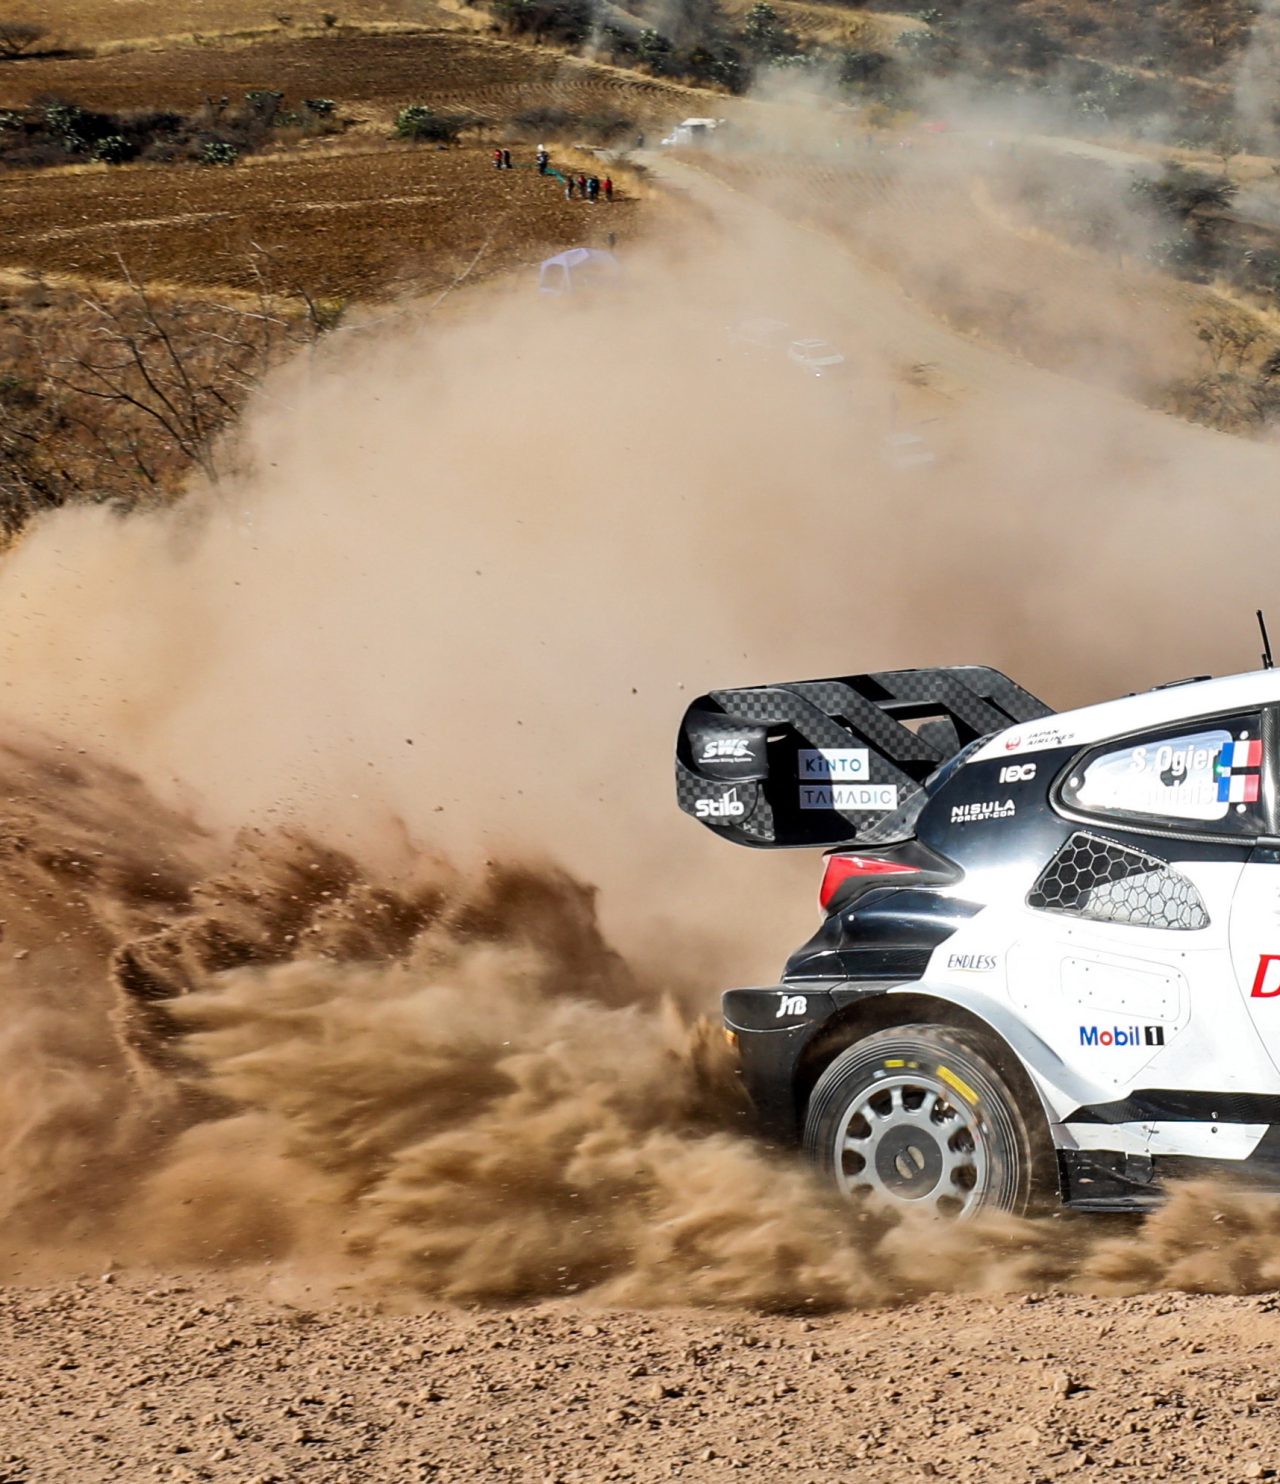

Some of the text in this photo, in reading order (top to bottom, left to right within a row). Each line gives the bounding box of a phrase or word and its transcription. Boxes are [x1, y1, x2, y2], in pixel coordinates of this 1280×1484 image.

[1154, 745, 1219, 775] Ogier
[695, 787, 745, 817] Stilo
[803, 790, 892, 805] TAMADIC
[951, 799, 1016, 817] NISULA
[947, 953, 998, 970] ENDLESS
[776, 995, 808, 1018] JTB
[1079, 1025, 1141, 1046] Mobil
